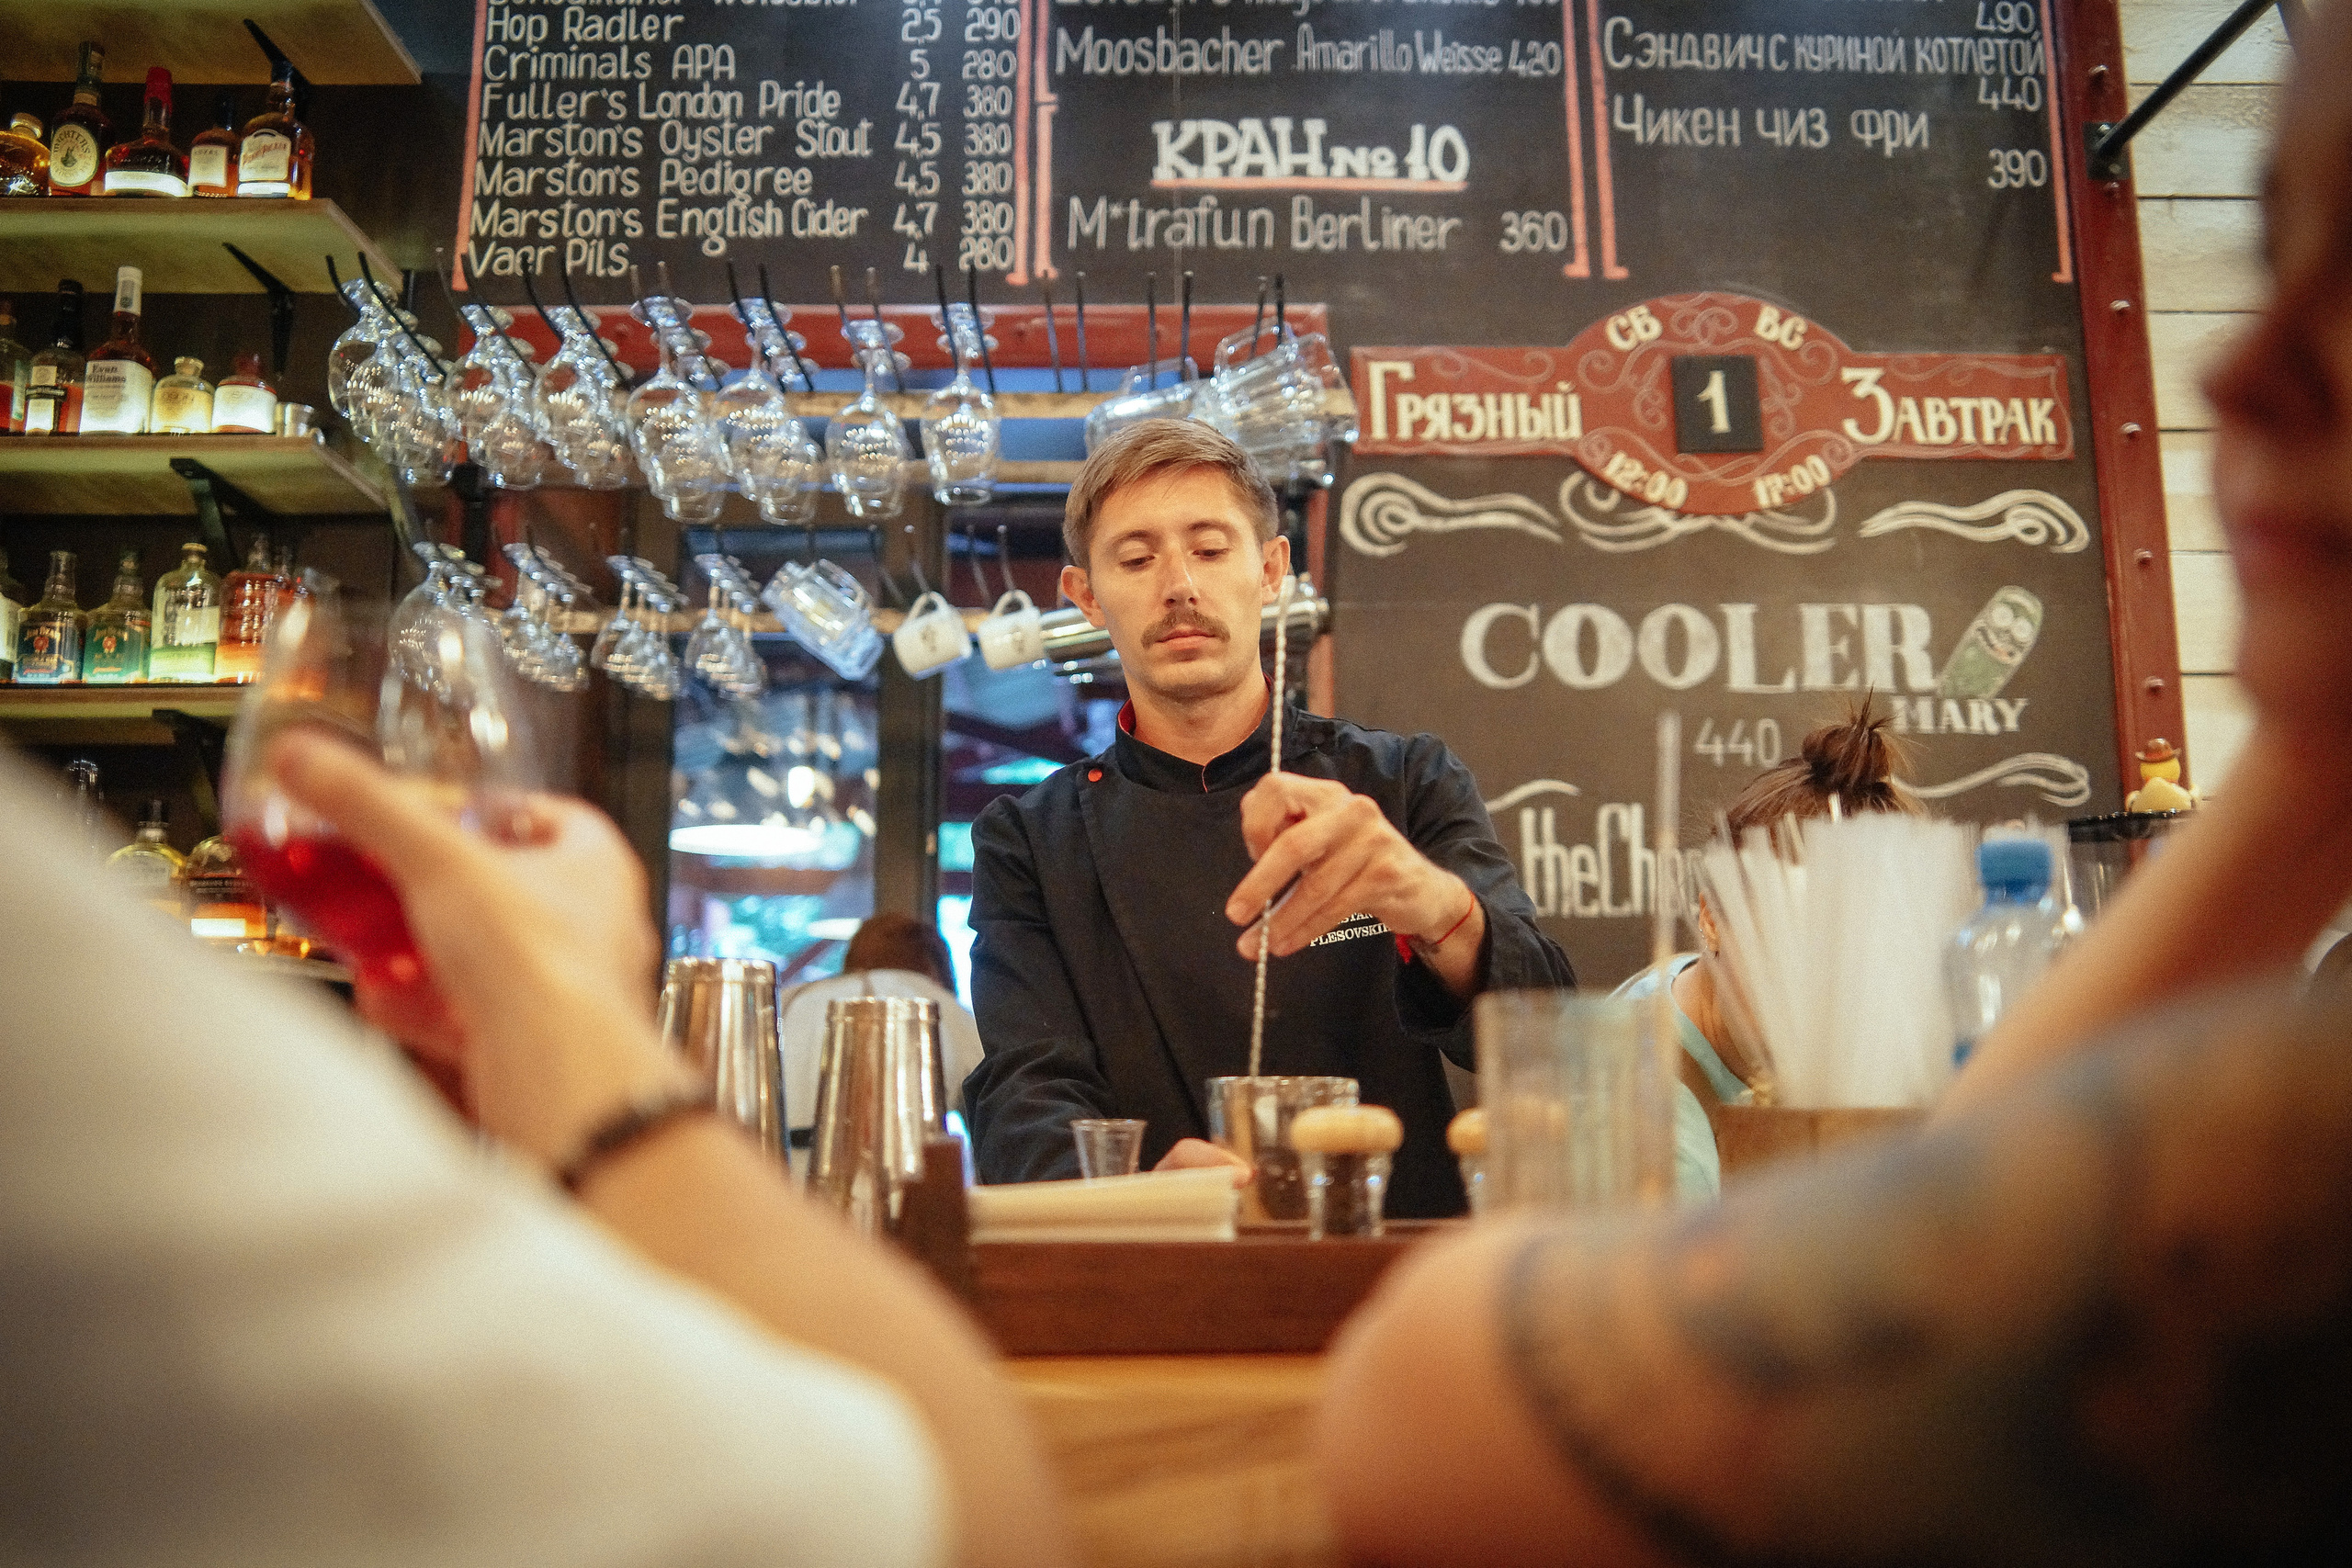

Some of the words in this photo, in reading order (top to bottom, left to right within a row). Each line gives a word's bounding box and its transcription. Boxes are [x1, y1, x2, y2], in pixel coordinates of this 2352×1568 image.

[486, 6, 548, 46] Hop
[563, 6, 684, 42] Radler
[965, 7, 1021, 42] 290
[1975, 1, 2035, 33] 490
[484, 44, 651, 81] Criminals
[672, 44, 735, 80] APA
[910, 49, 931, 80] 5
[962, 49, 1016, 80] 280
[1056, 25, 1285, 75] Moosbacher
[1296, 22, 1413, 73] Amarillo
[1415, 28, 1503, 73] Weisse
[1509, 39, 1562, 78] 420
[1604, 16, 1765, 71] Сэндвич
[1794, 28, 1906, 73] куриной
[1915, 30, 2046, 76] котлетой
[482, 82, 628, 120] Fuller's
[639, 81, 743, 119] London
[759, 80, 842, 118] Pride
[895, 81, 941, 120] 4,7
[963, 84, 1012, 118] 380
[1978, 76, 2041, 112] 440
[478, 118, 642, 158] Marston's
[660, 118, 775, 164] Oyster
[795, 118, 873, 158] Stout
[894, 121, 942, 159] 4,5
[964, 121, 1012, 156] 380
[1151, 116, 1328, 179] КРАН
[1405, 123, 1470, 182] 10
[1613, 93, 1741, 147] Чикен
[1756, 107, 1830, 148] чиз
[1850, 108, 1929, 158] фри
[474, 156, 640, 197] Marston's
[660, 158, 813, 206] Pedigree
[894, 161, 941, 197] 4,5
[961, 161, 1012, 196] 380
[1988, 148, 2047, 189] 390
[469, 198, 644, 239] Marston's
[656, 197, 784, 256] English
[791, 197, 869, 238] Cider
[892, 202, 939, 241] 4,7
[960, 199, 1013, 235] 380
[1291, 195, 1463, 253] Berliner
[1499, 210, 1568, 254] 360
[566, 238, 629, 276] Pils
[903, 243, 930, 273] 4
[959, 235, 1014, 271] 280
[1696, 370, 1731, 434] 1
[1461, 602, 1940, 695] COOLER
[1889, 695, 2030, 735] MARY
[1694, 716, 1781, 769] 440
